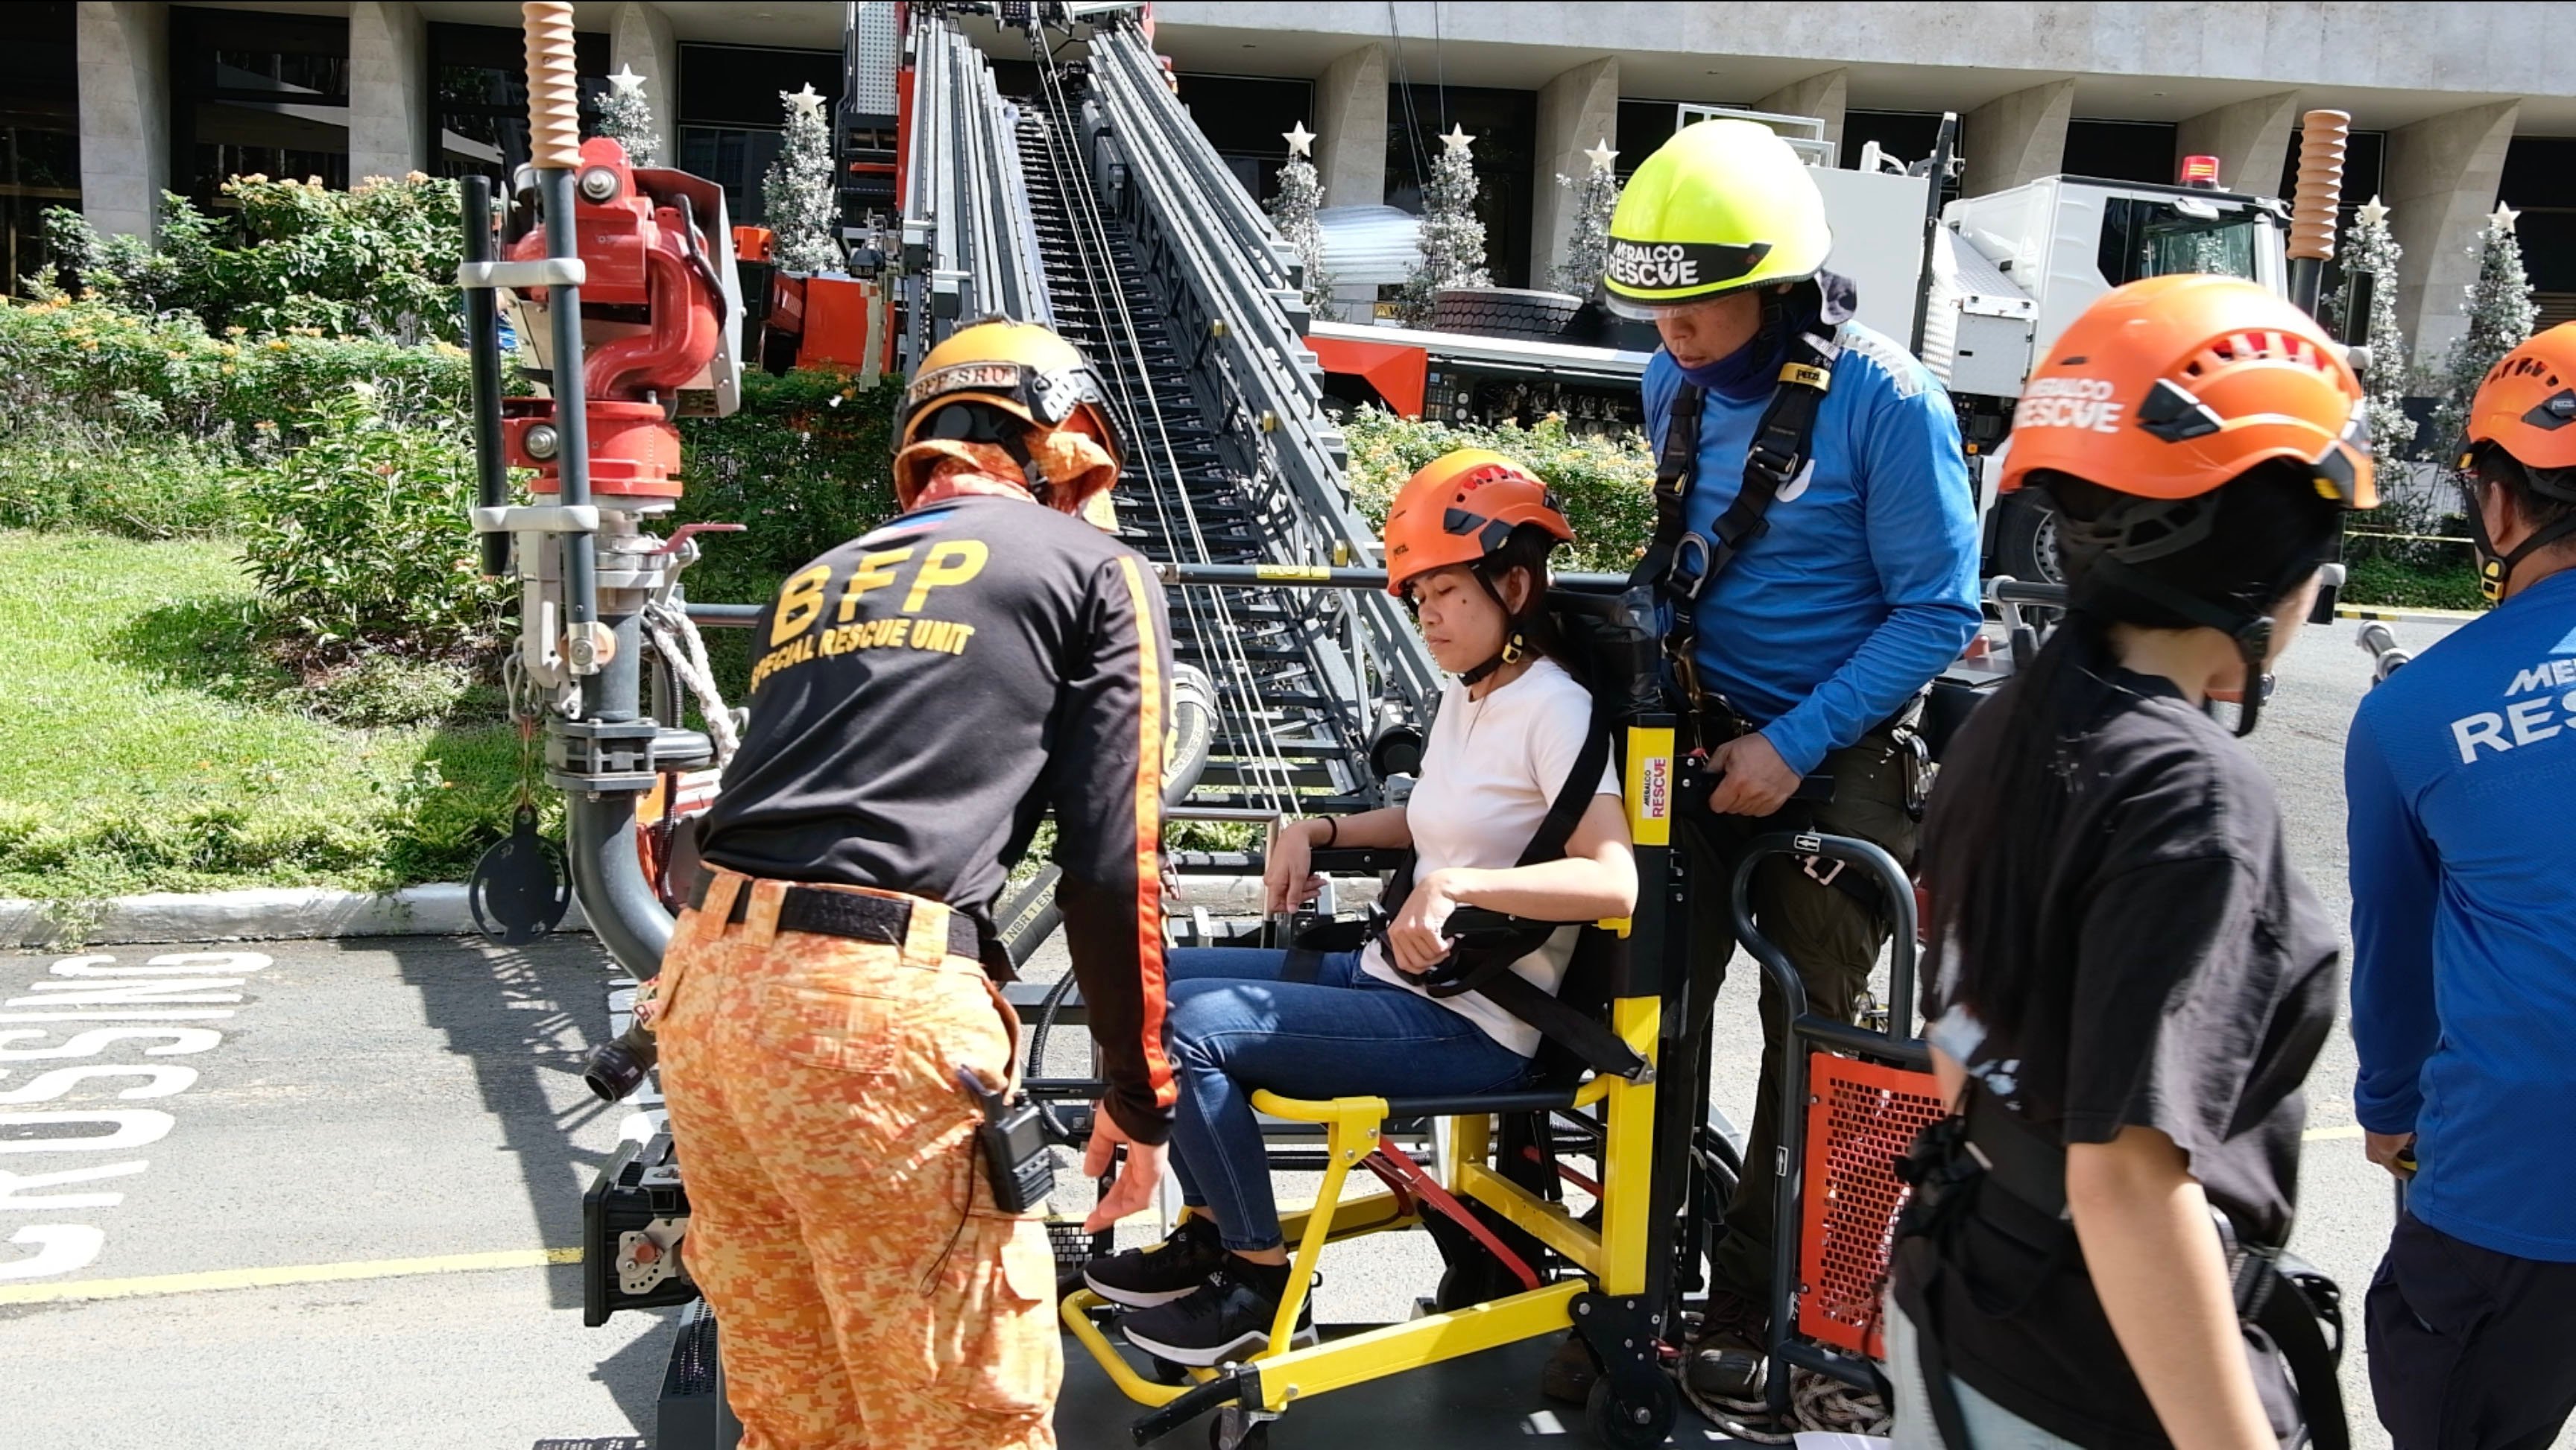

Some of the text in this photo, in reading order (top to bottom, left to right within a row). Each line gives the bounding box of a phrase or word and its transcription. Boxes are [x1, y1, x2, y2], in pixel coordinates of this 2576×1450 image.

[1608, 253, 1699, 286] RESCUE
[1614, 241, 1685, 263] MERALCO
[2014, 397, 2125, 434] RESCUE
[771, 539, 989, 648] BFP
[818, 619, 912, 657] RESCUE
[910, 619, 975, 655] UNIT
[2504, 658, 2576, 697] ME
[1652, 759, 1666, 817] RESCUE
[1007, 914, 1031, 940] NBR
[1035, 890, 1053, 907] EN
